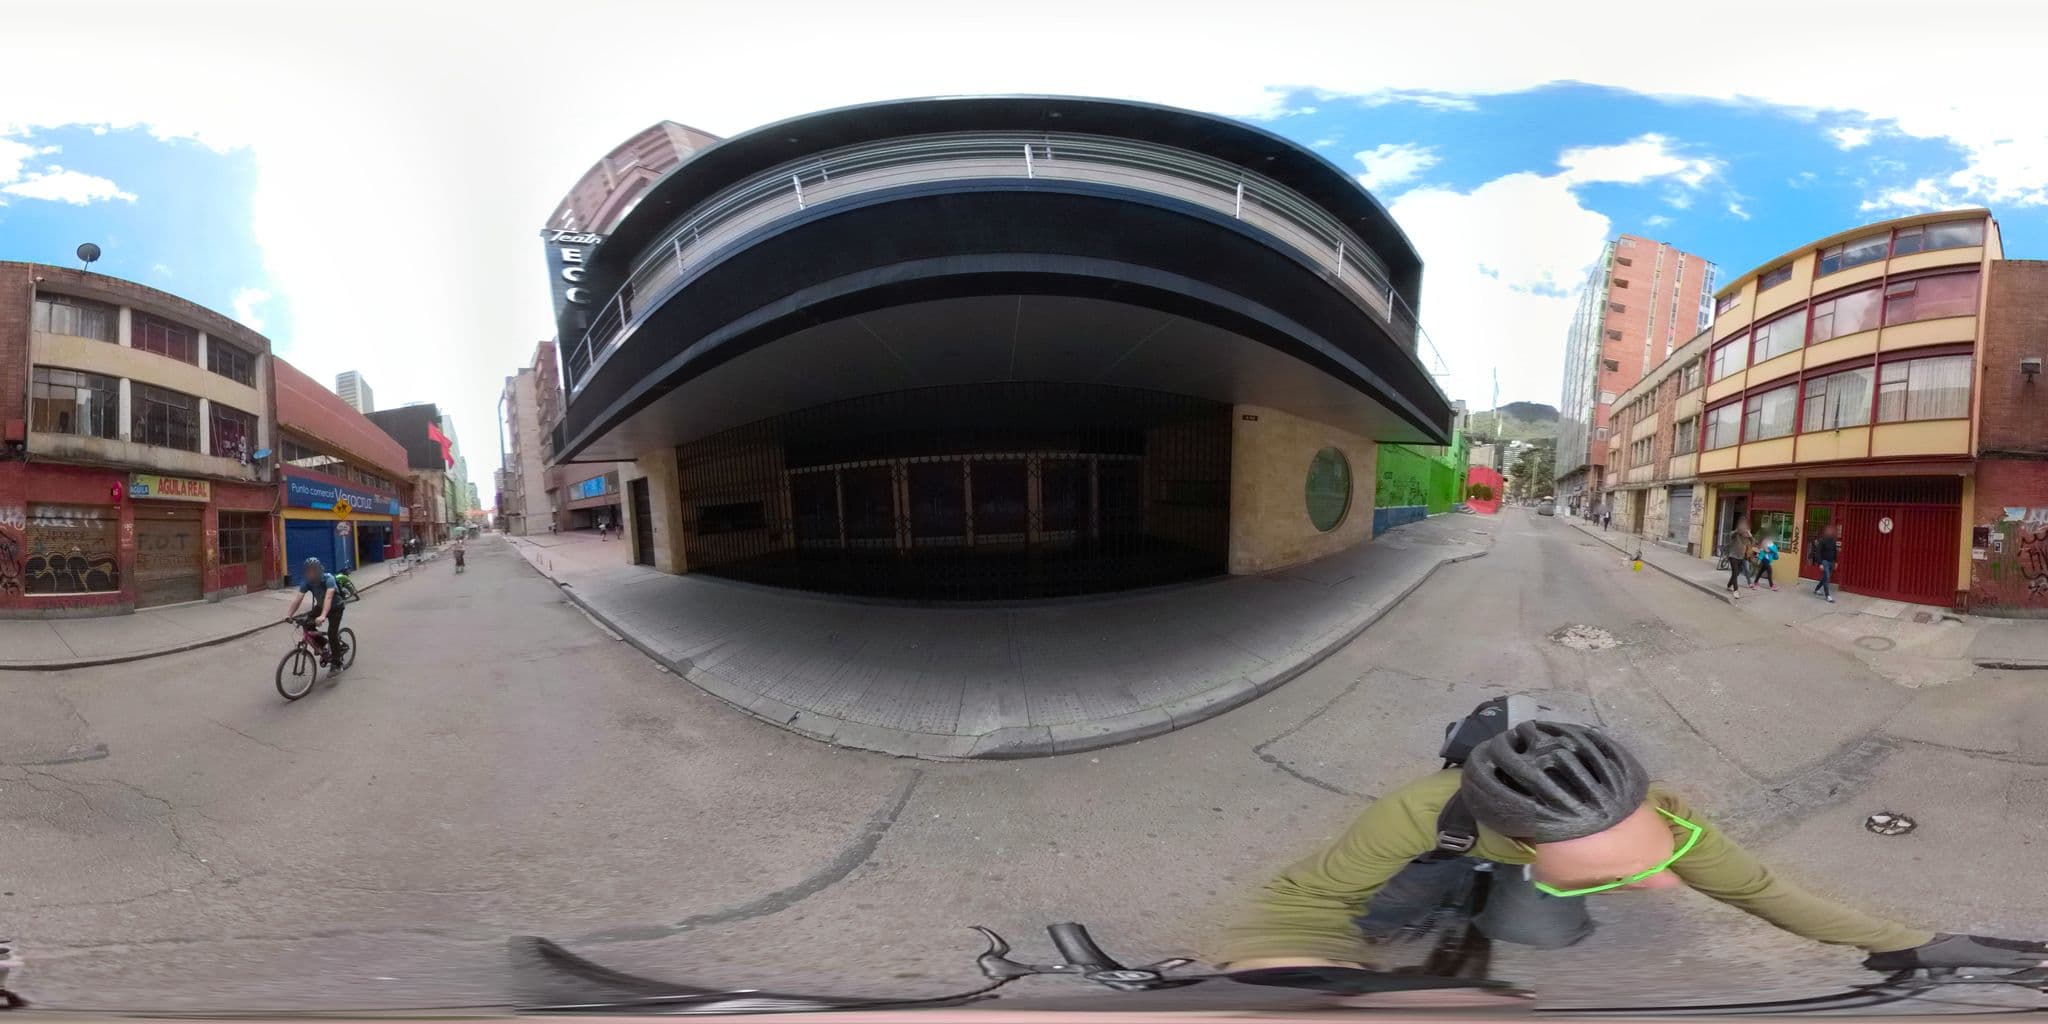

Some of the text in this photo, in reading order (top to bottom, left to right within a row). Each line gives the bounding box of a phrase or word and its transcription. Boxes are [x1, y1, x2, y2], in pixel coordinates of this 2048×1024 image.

[550, 229, 602, 244] Teatr
[187, 481, 207, 498] REAL
[291, 482, 309, 495] Punto
[334, 487, 373, 510] Veracruz
